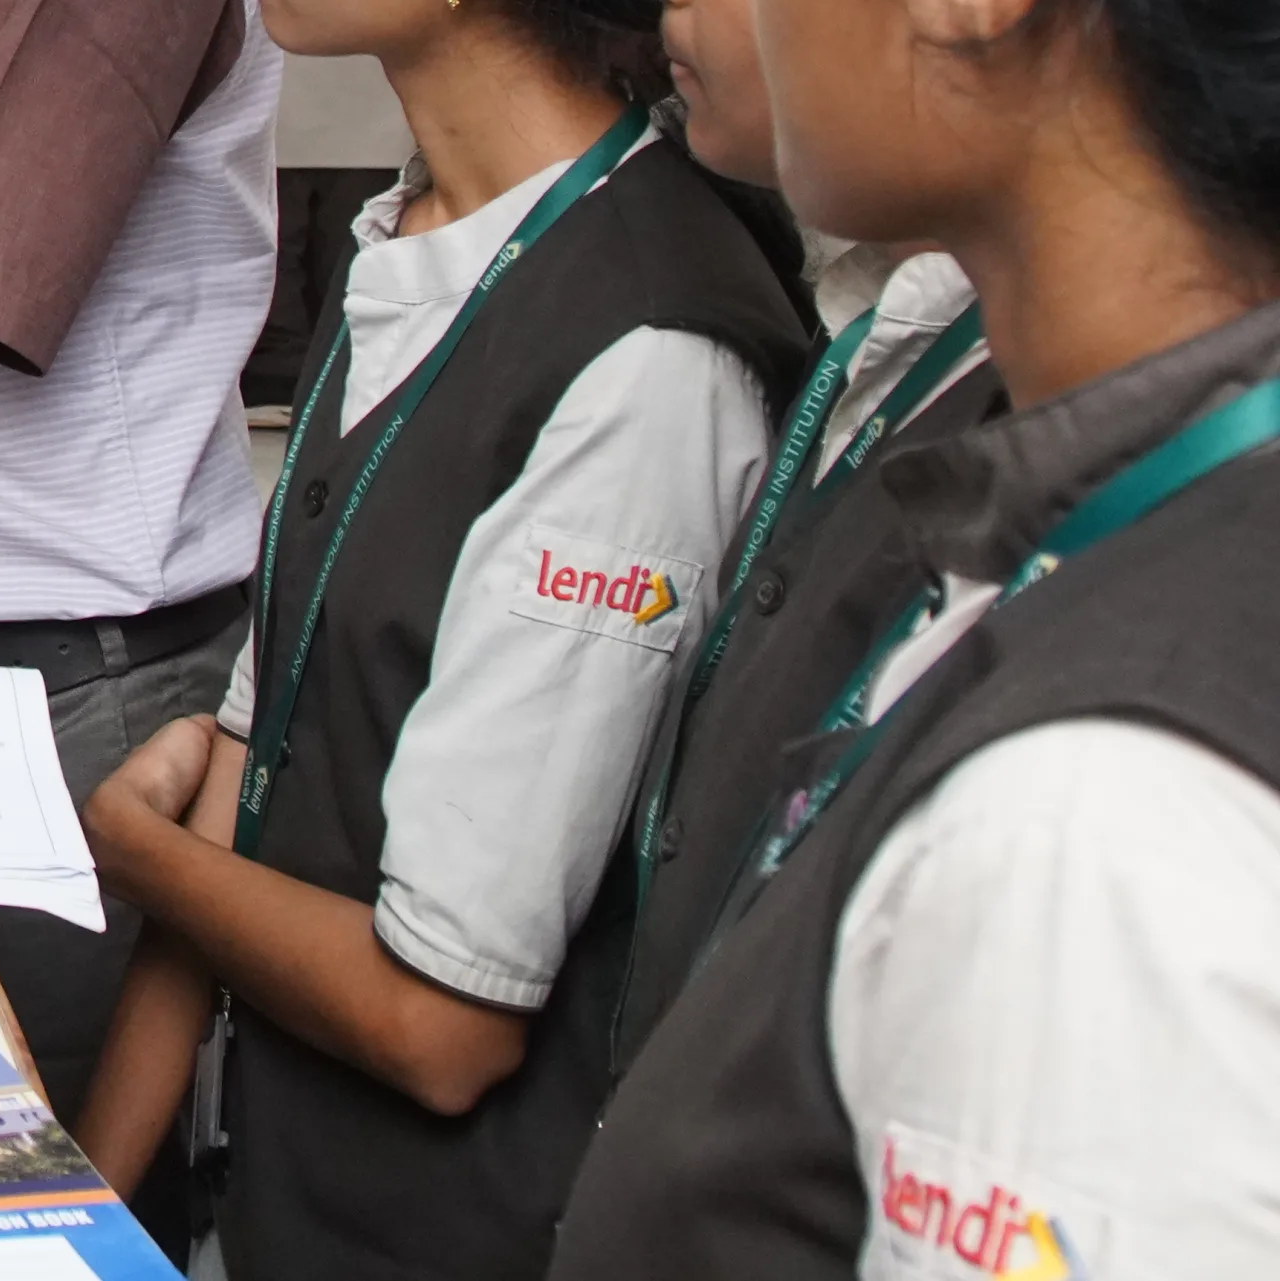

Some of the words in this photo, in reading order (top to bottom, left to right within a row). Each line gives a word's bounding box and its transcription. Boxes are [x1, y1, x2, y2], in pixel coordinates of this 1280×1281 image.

[734, 497, 776, 591] NOMOUS
[768, 358, 840, 494] INSTITUTION
[290, 653, 305, 682] AN
[299, 528, 344, 651] AUTONOMOUS
[341, 414, 404, 525] INSTITUTION
[538, 551, 652, 617] lendi
[30, 1208, 94, 1229] BOOK
[881, 1135, 1022, 1277] lendi
